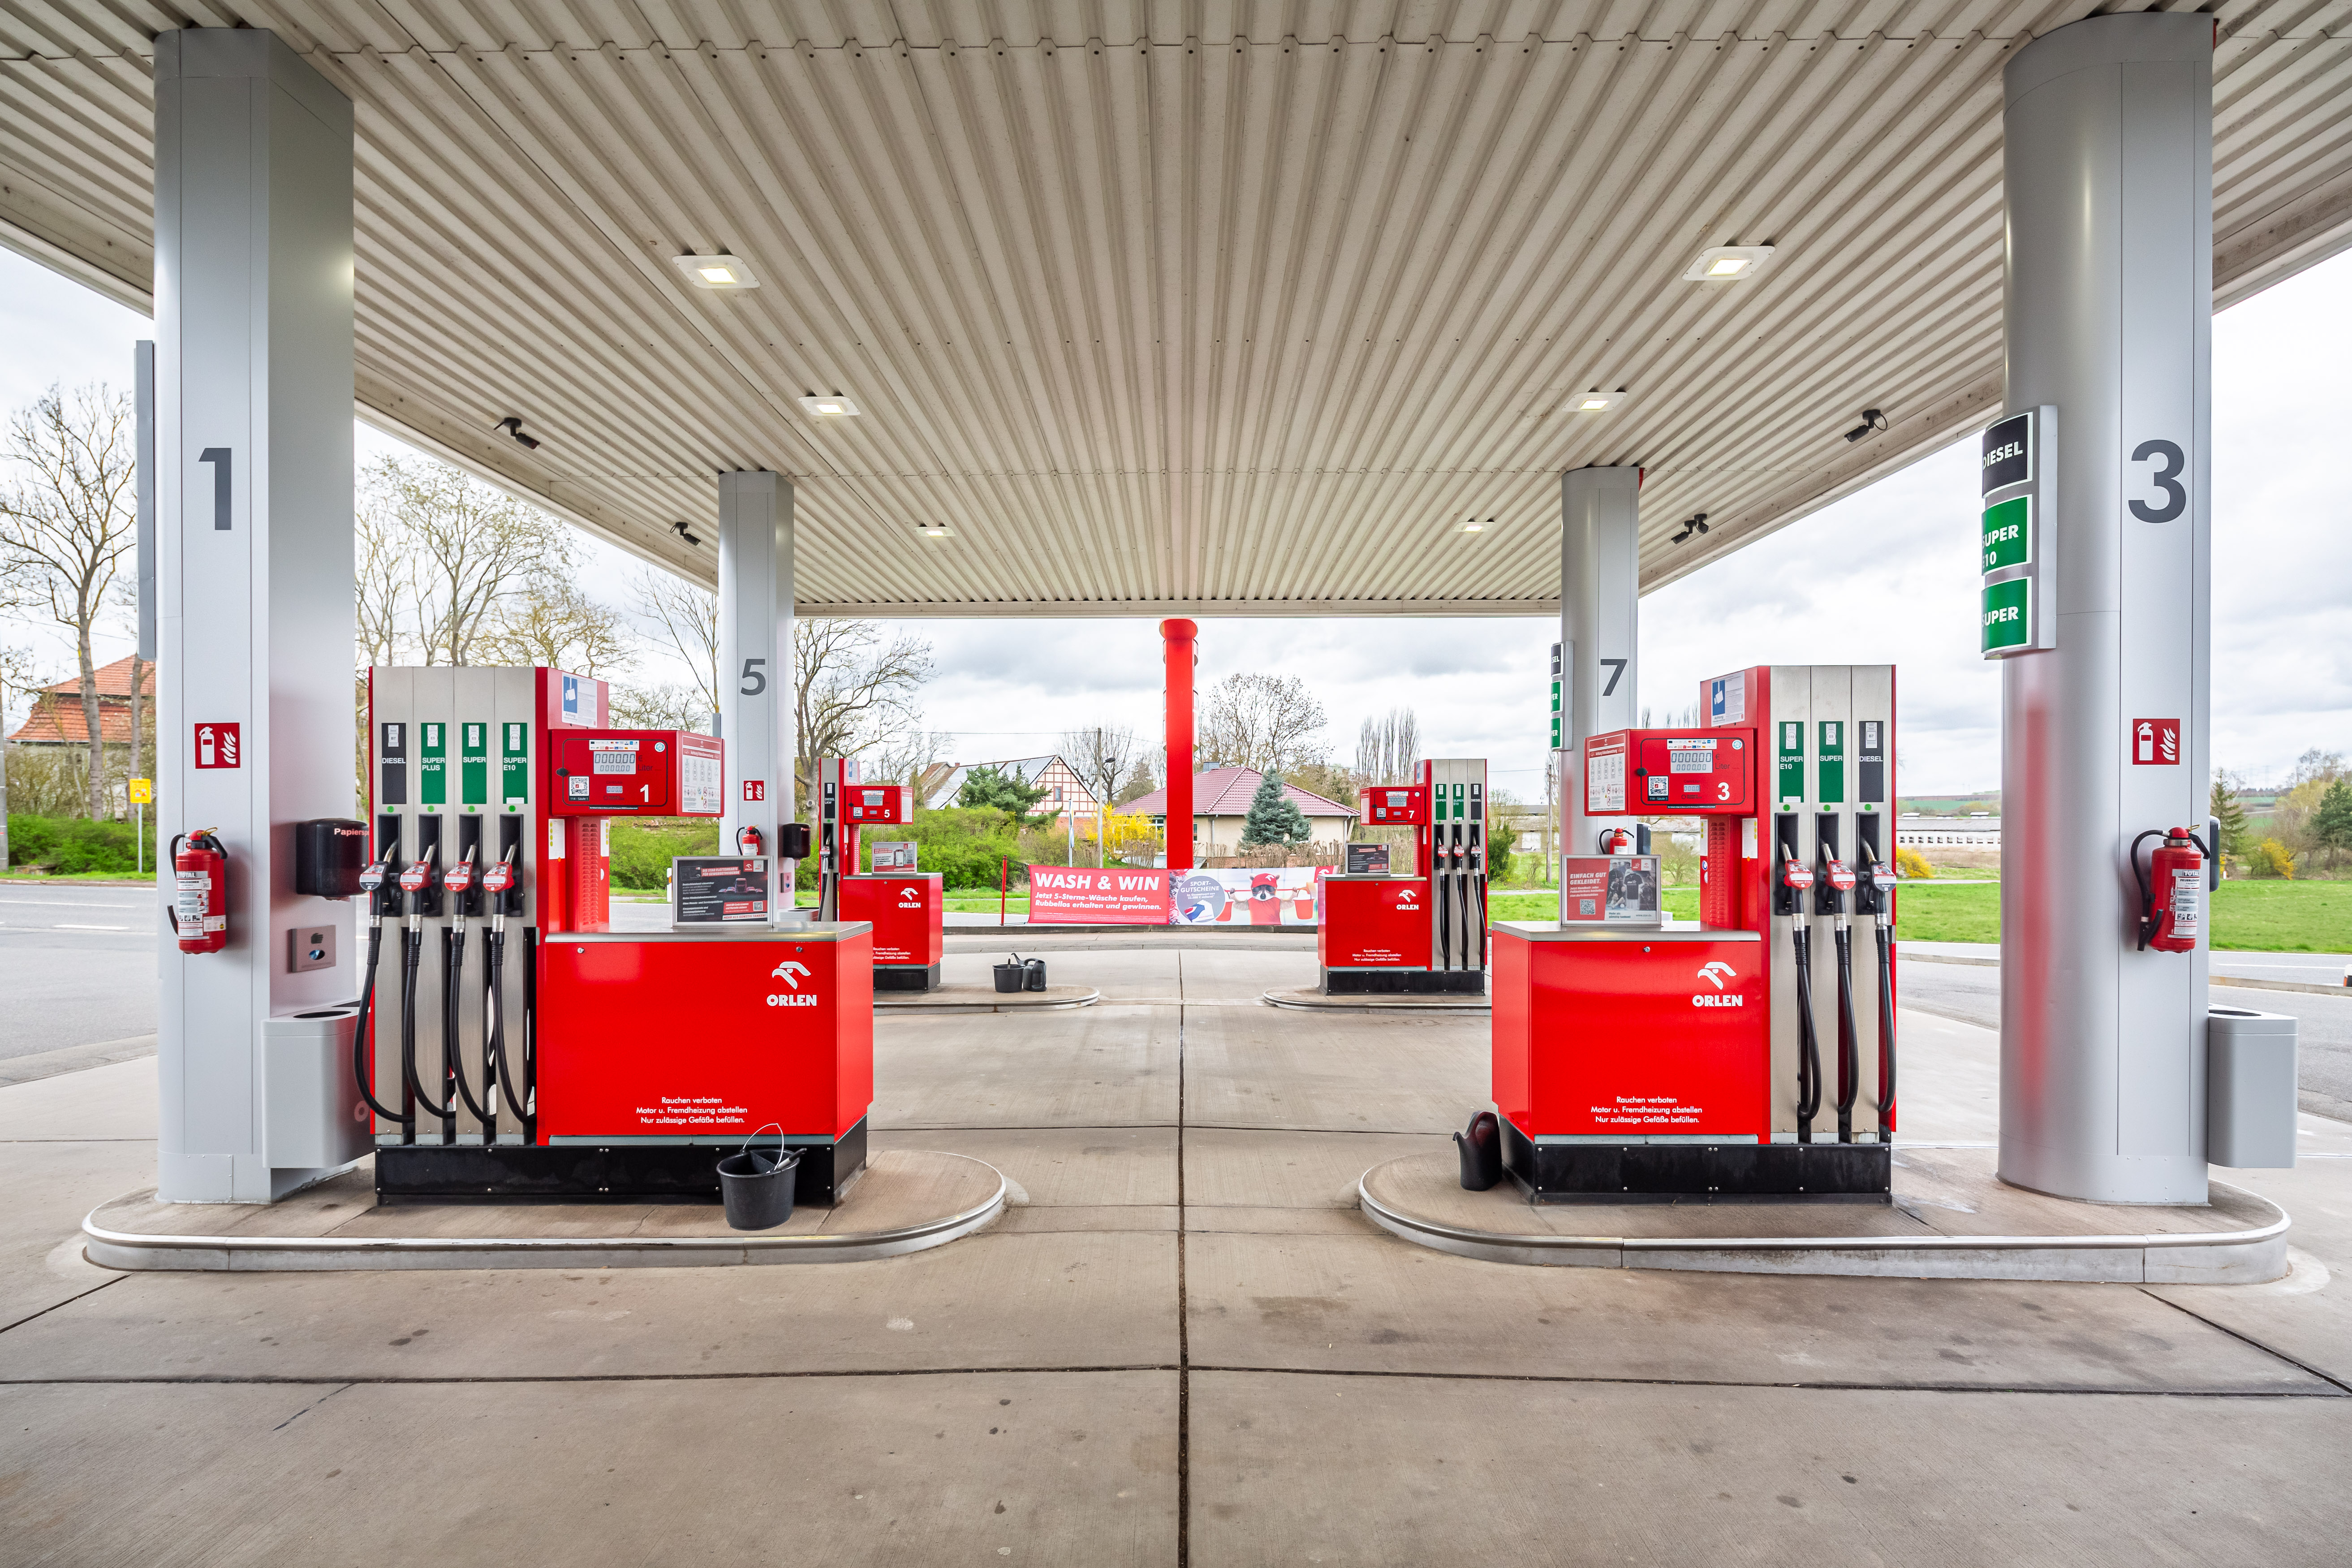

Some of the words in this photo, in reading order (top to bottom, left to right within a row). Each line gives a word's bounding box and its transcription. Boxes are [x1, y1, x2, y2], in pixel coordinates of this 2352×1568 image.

[1983, 441, 2023, 470] DIESEL
[2128, 439, 2186, 523] 3
[198, 448, 232, 530] 1
[741, 659, 766, 696] 5
[1601, 659, 1627, 696] 7
[640, 784, 649, 802] 1
[1718, 782, 1730, 801] 3
[884, 810, 890, 818] 5
[1409, 810, 1415, 819] 7
[1034, 872, 1091, 889] WASH
[1097, 876, 1111, 890] &
[1118, 876, 1159, 890] WIN
[1054, 893, 1117, 901] 5-Sterne-Wäsche
[1035, 900, 1070, 908] Rubbellos
[767, 994, 817, 1006] ORLEN
[1693, 995, 1743, 1006] ORLEN
[668, 1107, 715, 1115] Fremdheizung
[1622, 1106, 1670, 1114] Fremdheizung
[656, 1116, 686, 1125] zulässige
[1611, 1116, 1641, 1124] zulässige
